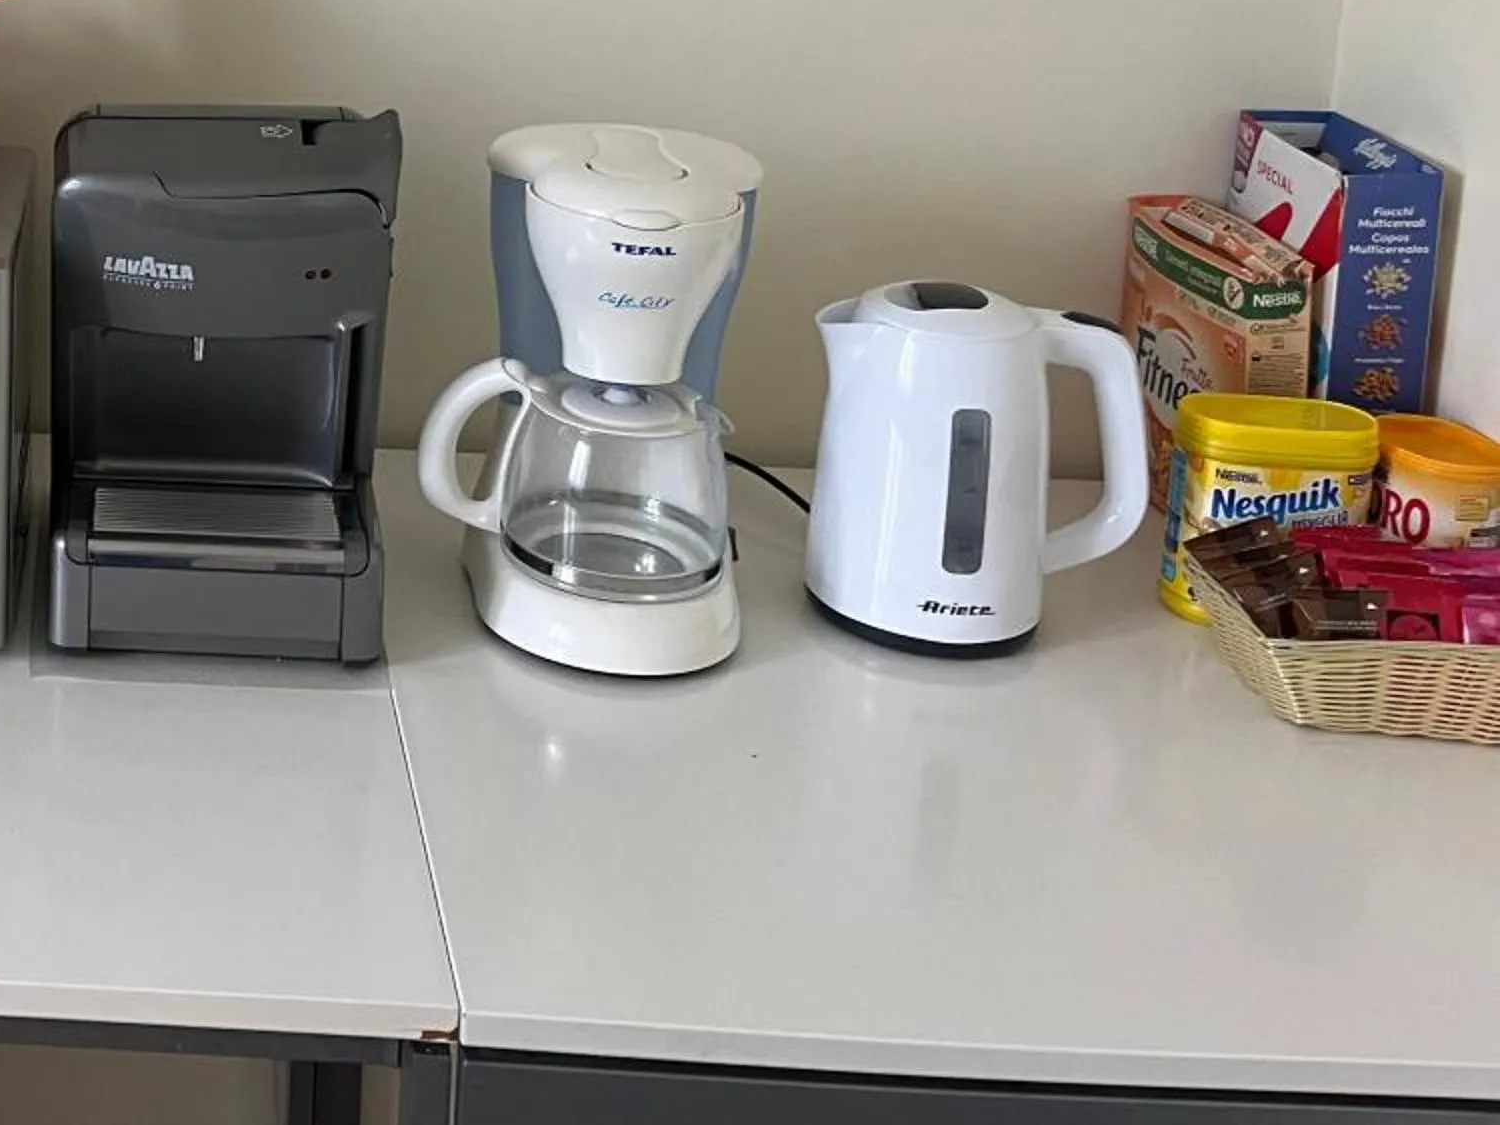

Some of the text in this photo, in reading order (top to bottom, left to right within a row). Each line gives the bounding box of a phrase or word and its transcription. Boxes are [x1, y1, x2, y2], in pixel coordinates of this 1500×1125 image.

[1257, 160, 1294, 194] SPECIAL
[612, 241, 677, 256] TEFAL
[103, 255, 195, 282] LAVAZZA
[1136, 324, 1201, 411] Fitne
[1211, 478, 1341, 527] Nesquik
[917, 600, 997, 616] Ariete
